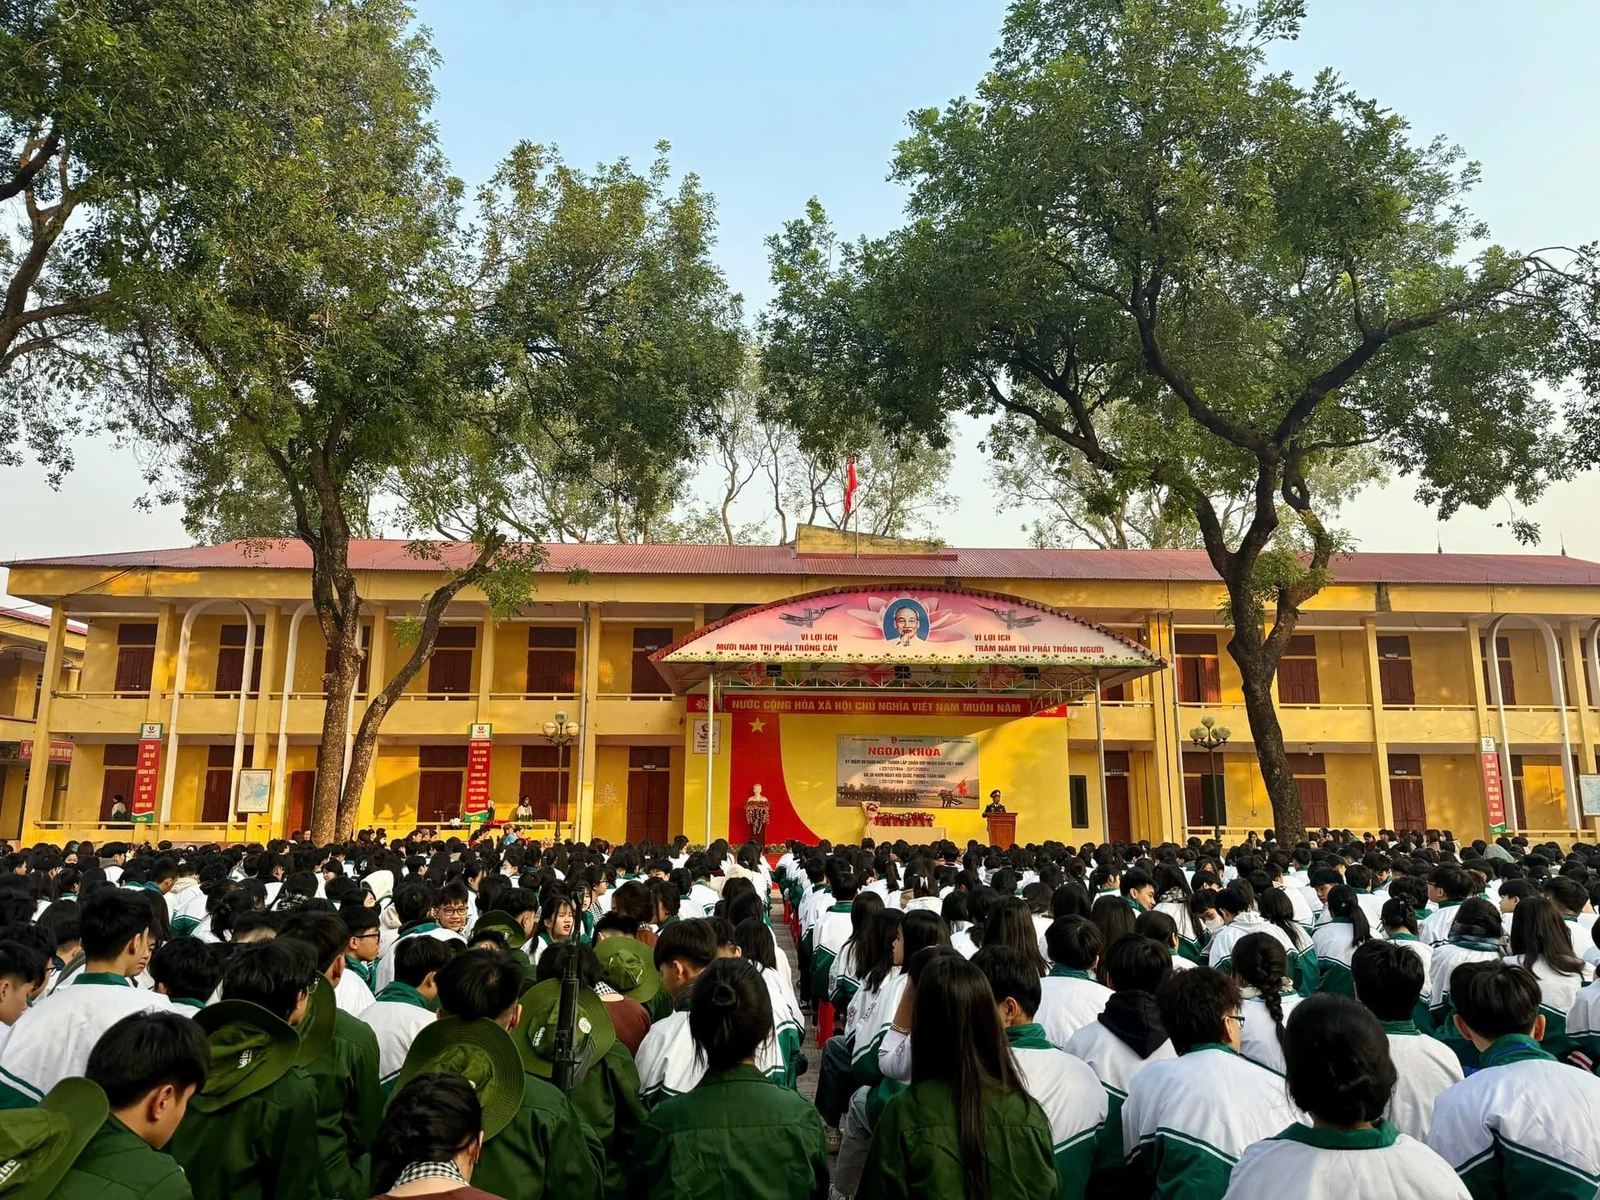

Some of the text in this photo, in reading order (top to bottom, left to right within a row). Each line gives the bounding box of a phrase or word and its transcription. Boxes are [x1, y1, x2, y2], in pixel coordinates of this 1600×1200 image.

[800, 632, 838, 642] VÌ LỢI ÍCH
[974, 633, 1011, 643] VÌ LỢI ÍCH
[716, 642, 838, 652] MƯỜI NĂM THÌ PHẢI TRỒNG CÂY
[975, 644, 1104, 654] TRĂM NĂM THÌ PHẢI TRỒNG NGƯỜI
[732, 698, 1021, 713] NƯỚC CỘNG HÒA XÃ HỘI CHỦ NGHĨA VIỆT NAM MUÔN NĂM
[868, 746, 941, 757] NGOẠI KHÓA
